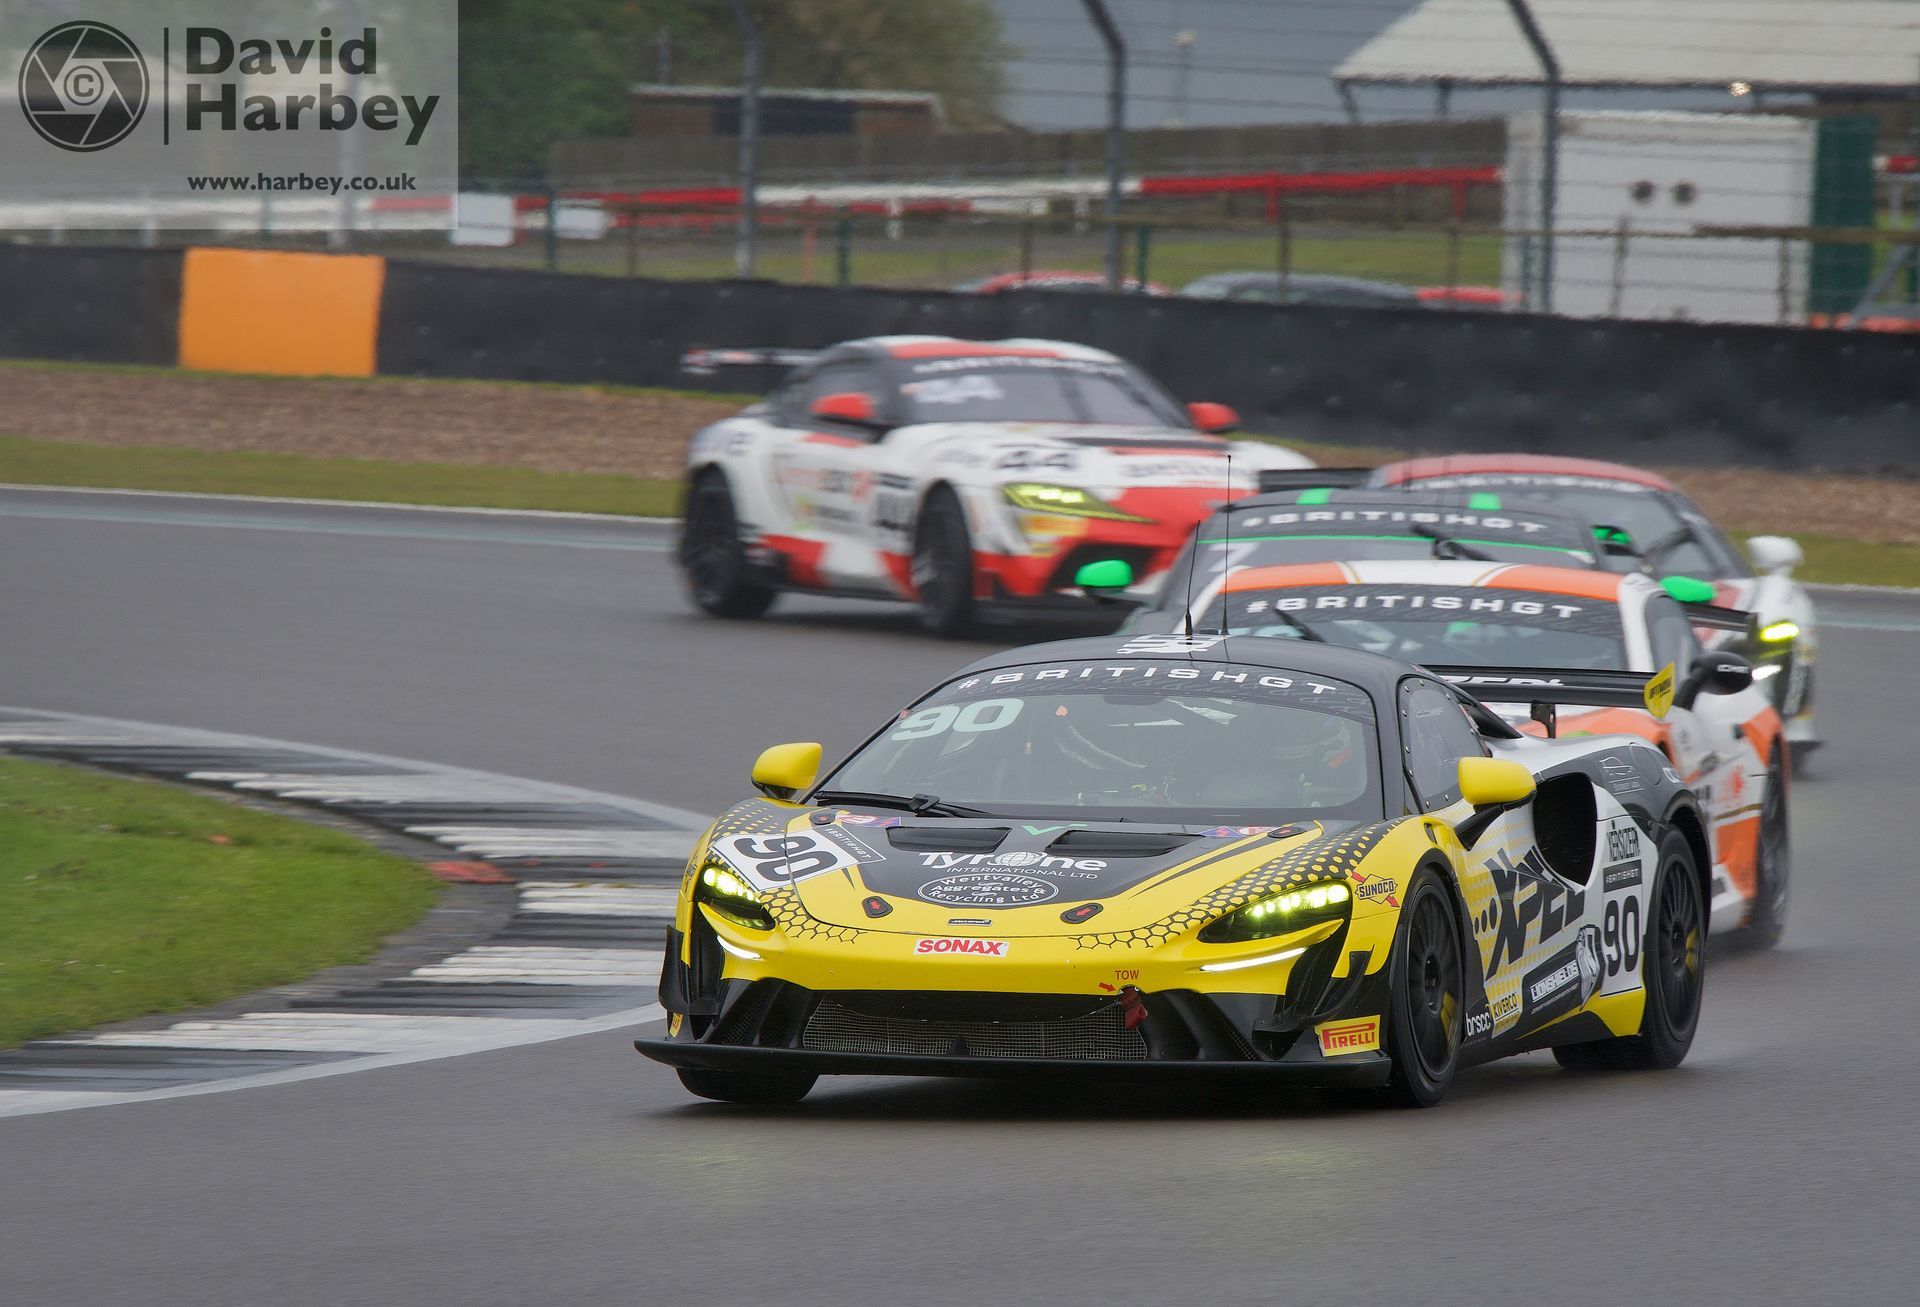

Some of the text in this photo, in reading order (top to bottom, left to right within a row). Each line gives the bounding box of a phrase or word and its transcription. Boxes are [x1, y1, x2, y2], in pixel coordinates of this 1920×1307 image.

[1242, 510, 1547, 533] #BRITISHGT
[1246, 595, 1583, 619] #BRITISHGT
[957, 667, 1337, 694] #BRITISHGT
[890, 698, 1025, 741] 90
[733, 836, 838, 882] 90
[940, 874, 1039, 890] Wentvalley
[946, 867, 1099, 879] INTERNATIONAL LTD
[928, 890, 1039, 904] Recycling Ltd
[931, 884, 1029, 893] Aggregates
[1359, 880, 1395, 898] SUNOCO
[917, 939, 1003, 955] SONAX
[1604, 895, 1640, 978] 90
[1114, 969, 1140, 981] TOW
[1322, 1022, 1376, 1050] PIRELLI
[1465, 1012, 1492, 1037] brscc
